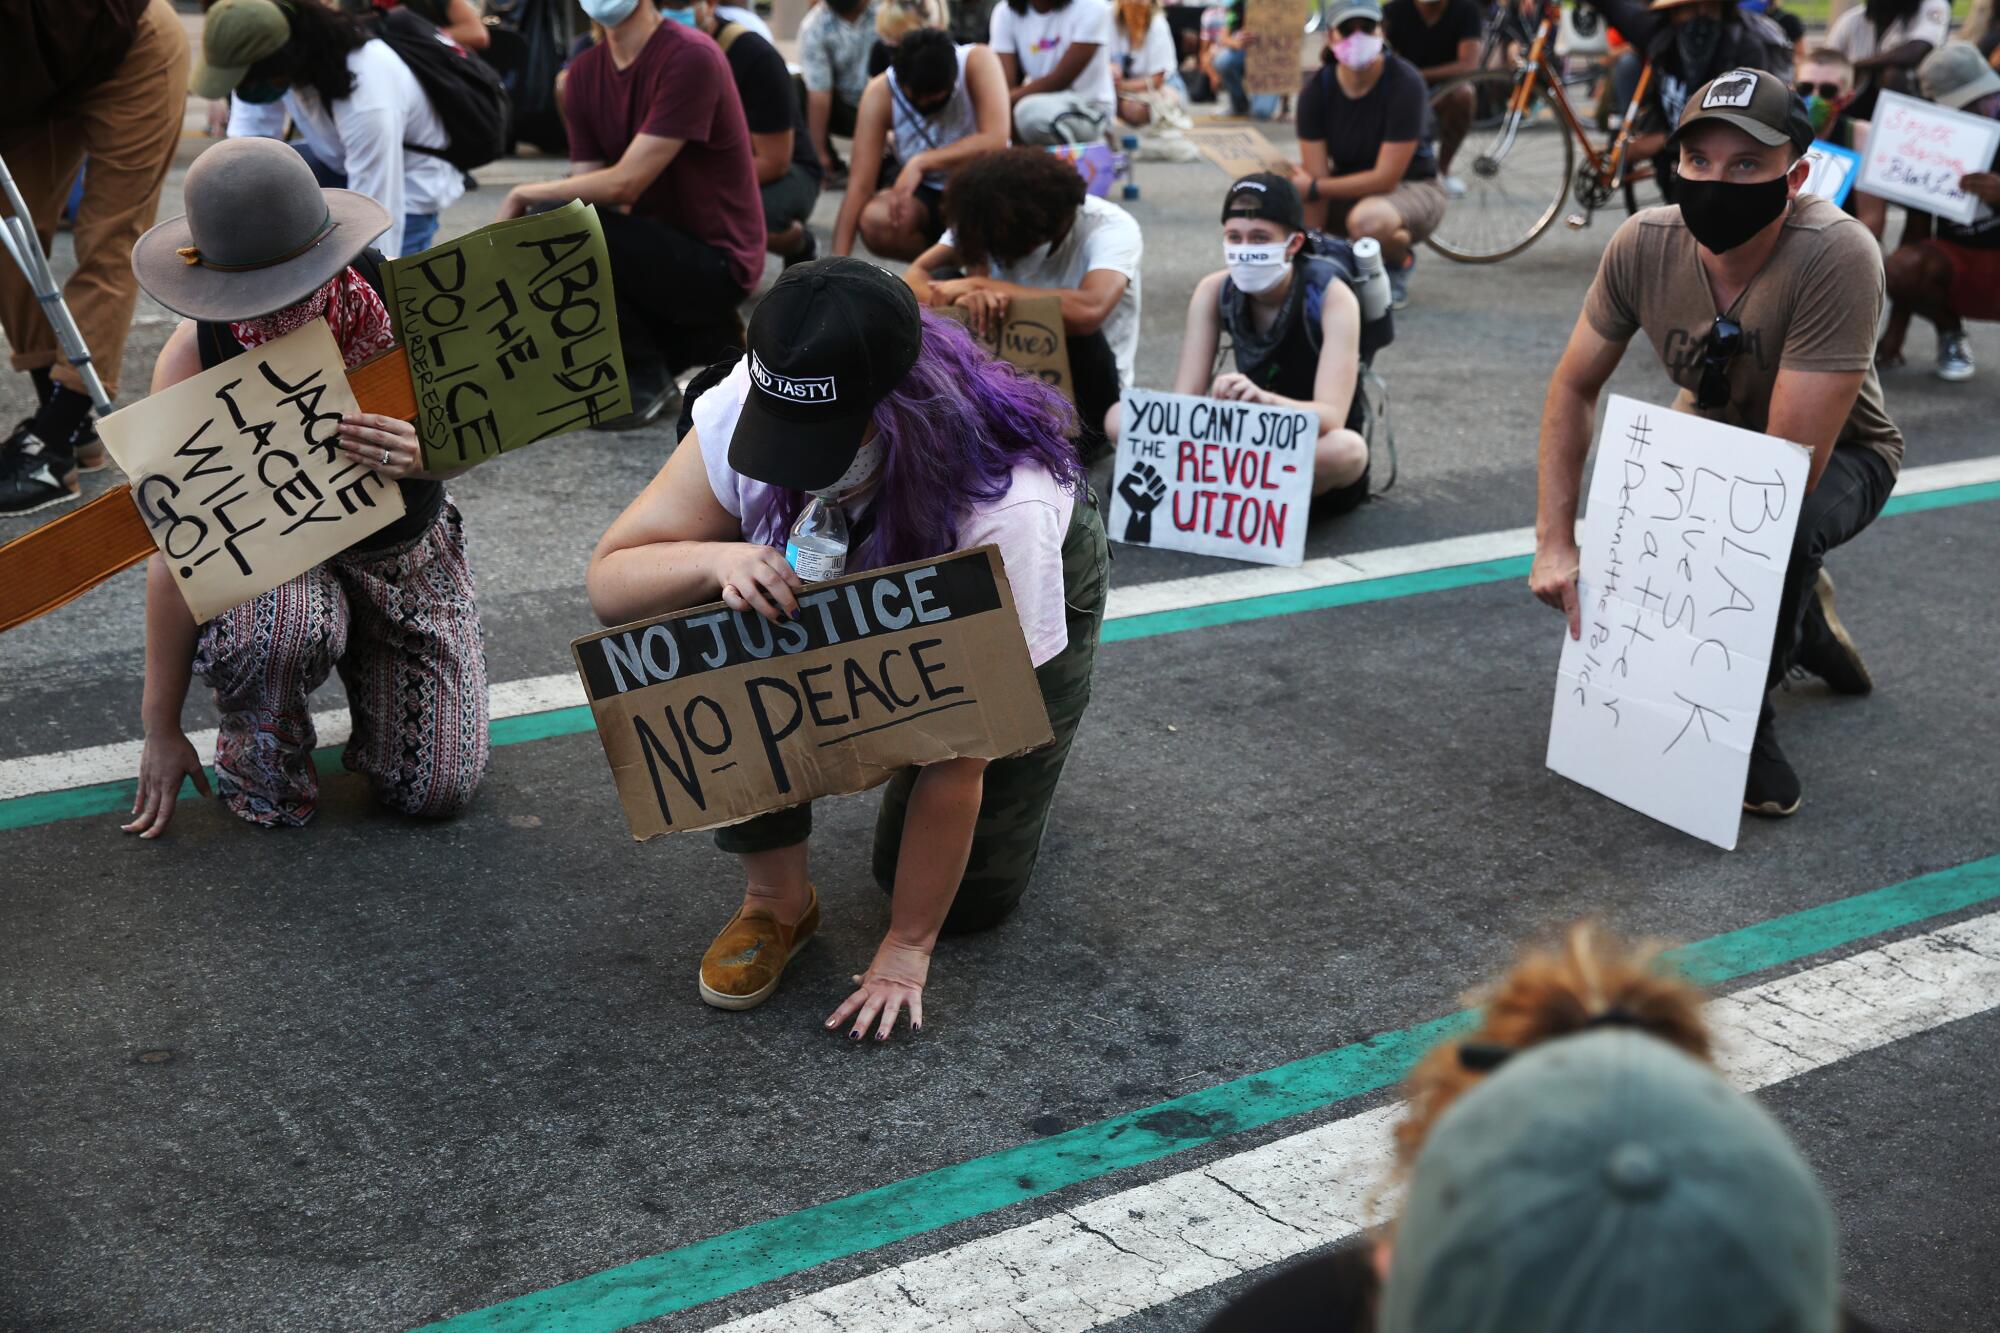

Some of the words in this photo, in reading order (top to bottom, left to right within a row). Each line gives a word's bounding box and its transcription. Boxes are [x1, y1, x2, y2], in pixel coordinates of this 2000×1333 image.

[397, 286, 450, 450] (MURDERERS)
[400, 246, 504, 461] POLICE
[476, 278, 540, 381] THE
[516, 230, 621, 444] ABOLISH
[774, 377, 830, 398] TASTY
[215, 377, 342, 536] LACEY
[1128, 398, 1180, 436] YOU
[1252, 411, 1307, 450] STOP
[1128, 438, 1166, 459] THE
[1176, 440, 1297, 490] REVOL-
[138, 474, 221, 579] GO!
[173, 418, 267, 577] WILL
[1172, 490, 1288, 549] UTION
[600, 623, 680, 693] NO
[686, 566, 952, 668] JUSTICE
[1662, 468, 1787, 755] BLACK
[746, 637, 965, 795] PEACE
